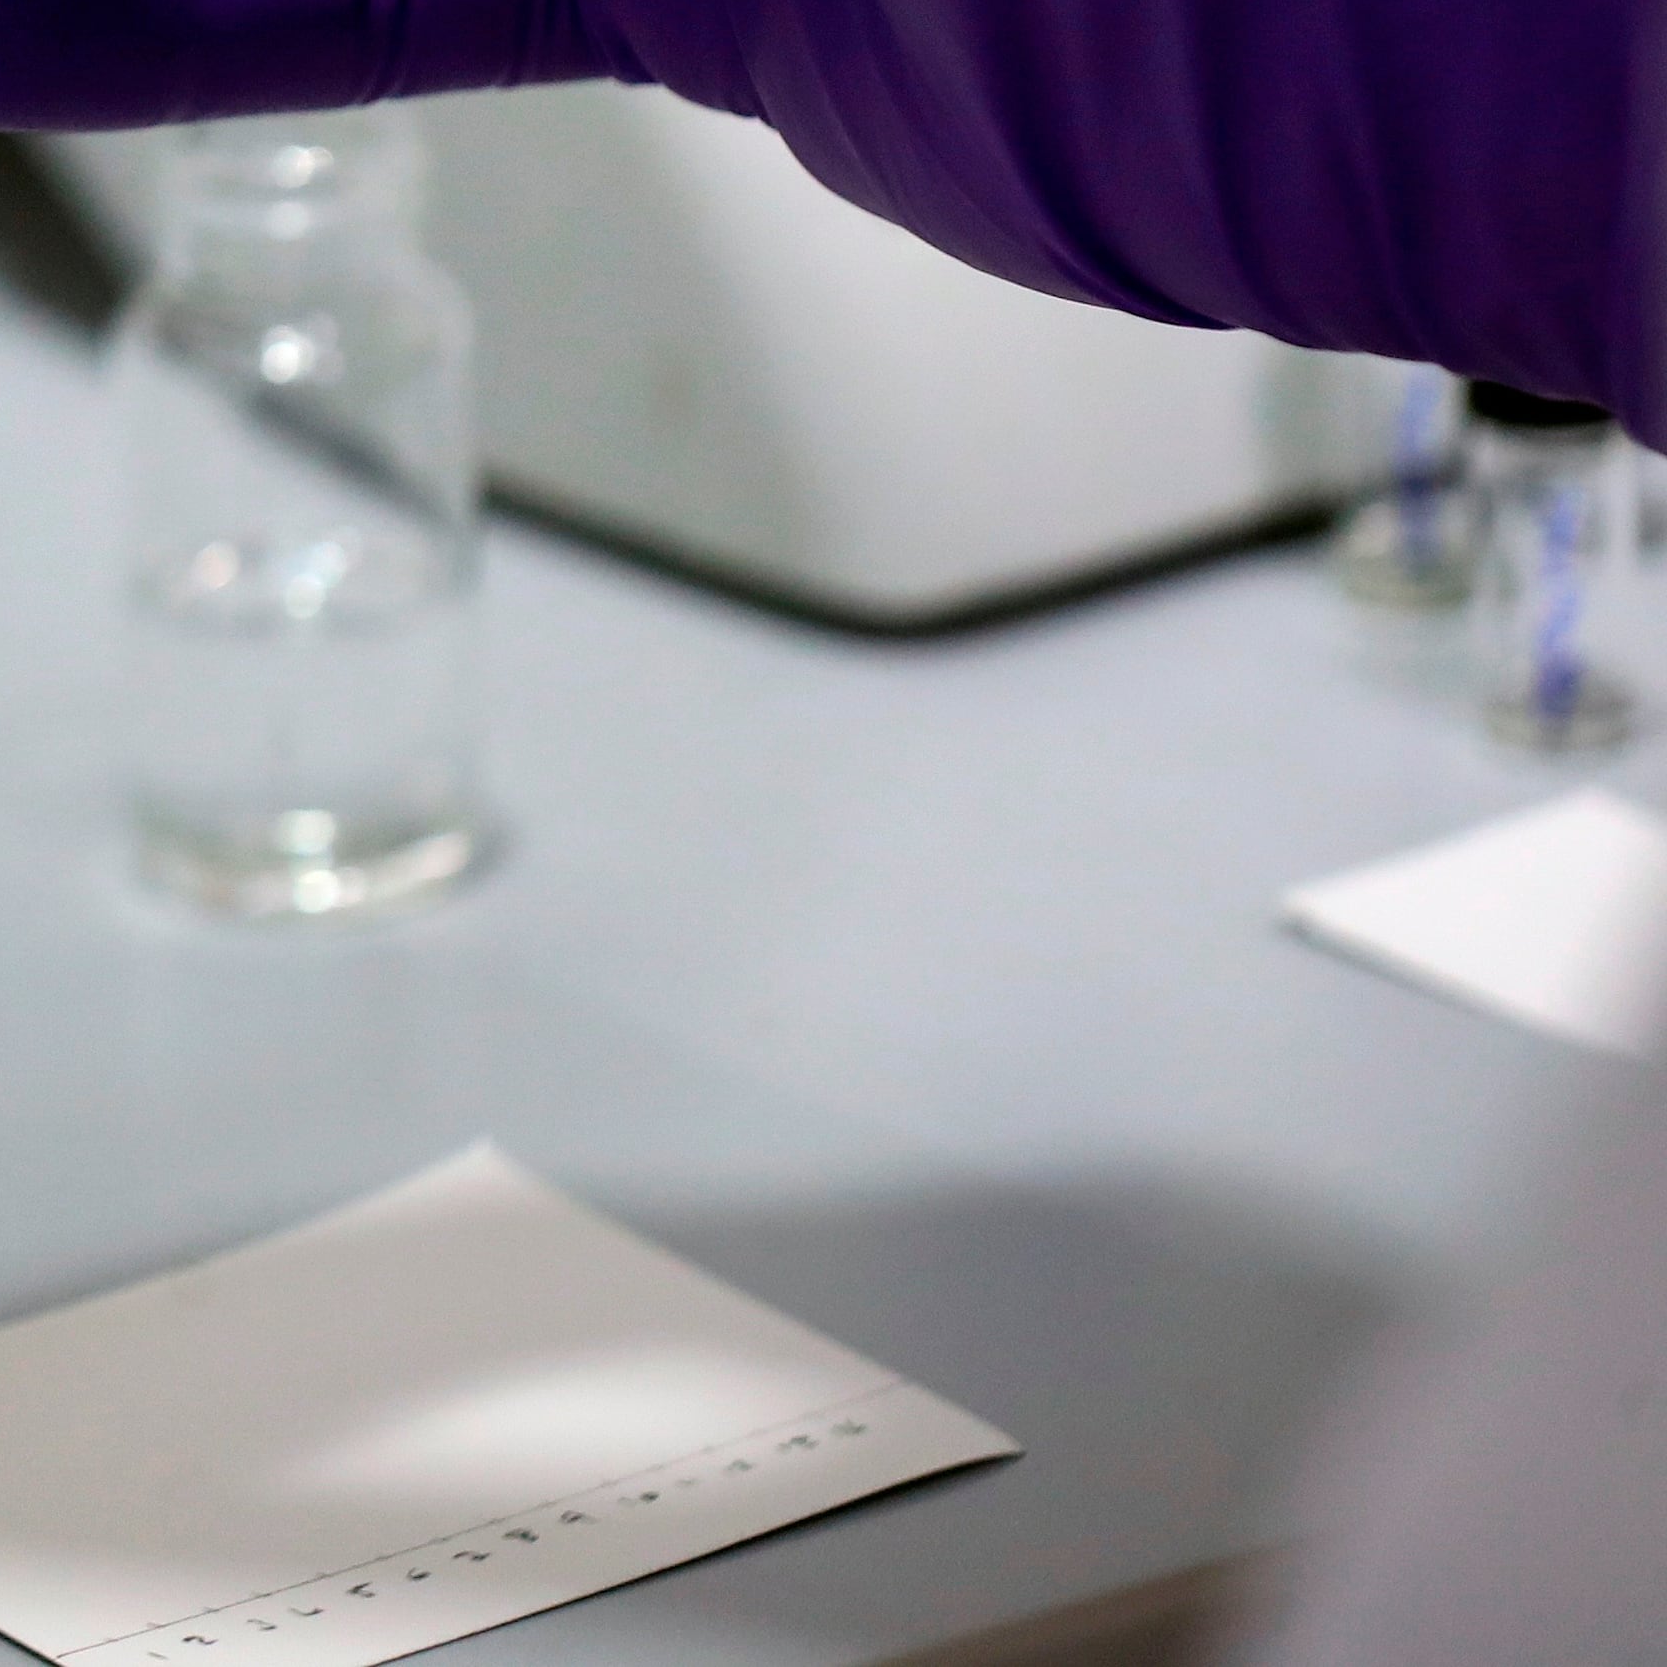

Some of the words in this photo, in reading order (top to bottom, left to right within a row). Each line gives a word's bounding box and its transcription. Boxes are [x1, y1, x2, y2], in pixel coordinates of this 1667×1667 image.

[181, 1635, 218, 1646] 2
[344, 1581, 377, 1599] 5
[405, 1567, 432, 1582] 6
